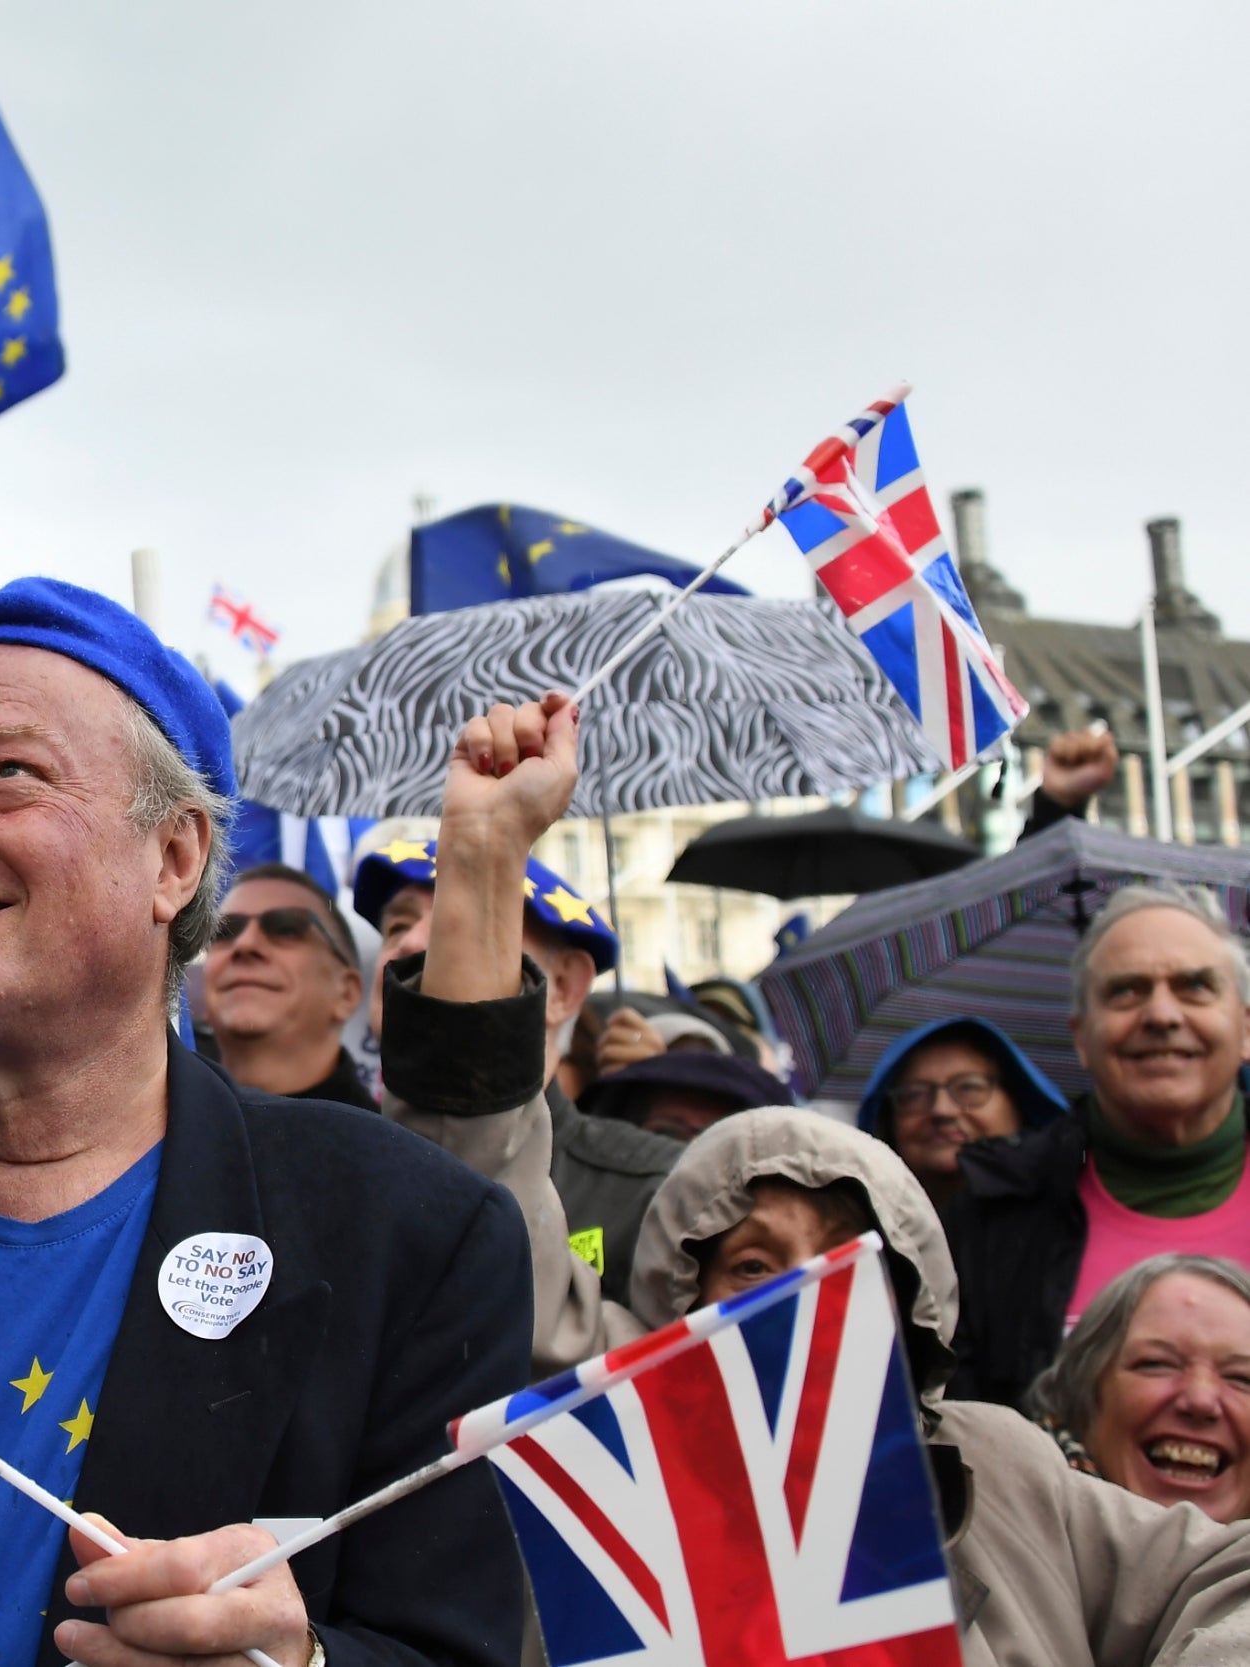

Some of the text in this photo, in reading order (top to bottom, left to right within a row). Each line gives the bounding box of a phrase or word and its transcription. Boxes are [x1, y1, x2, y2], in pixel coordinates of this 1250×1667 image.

[190, 1245, 255, 1265] SAY NO
[175, 1256, 268, 1279] TO NO SAY
[167, 1272, 263, 1295] Let the People
[201, 1292, 234, 1306] Vote
